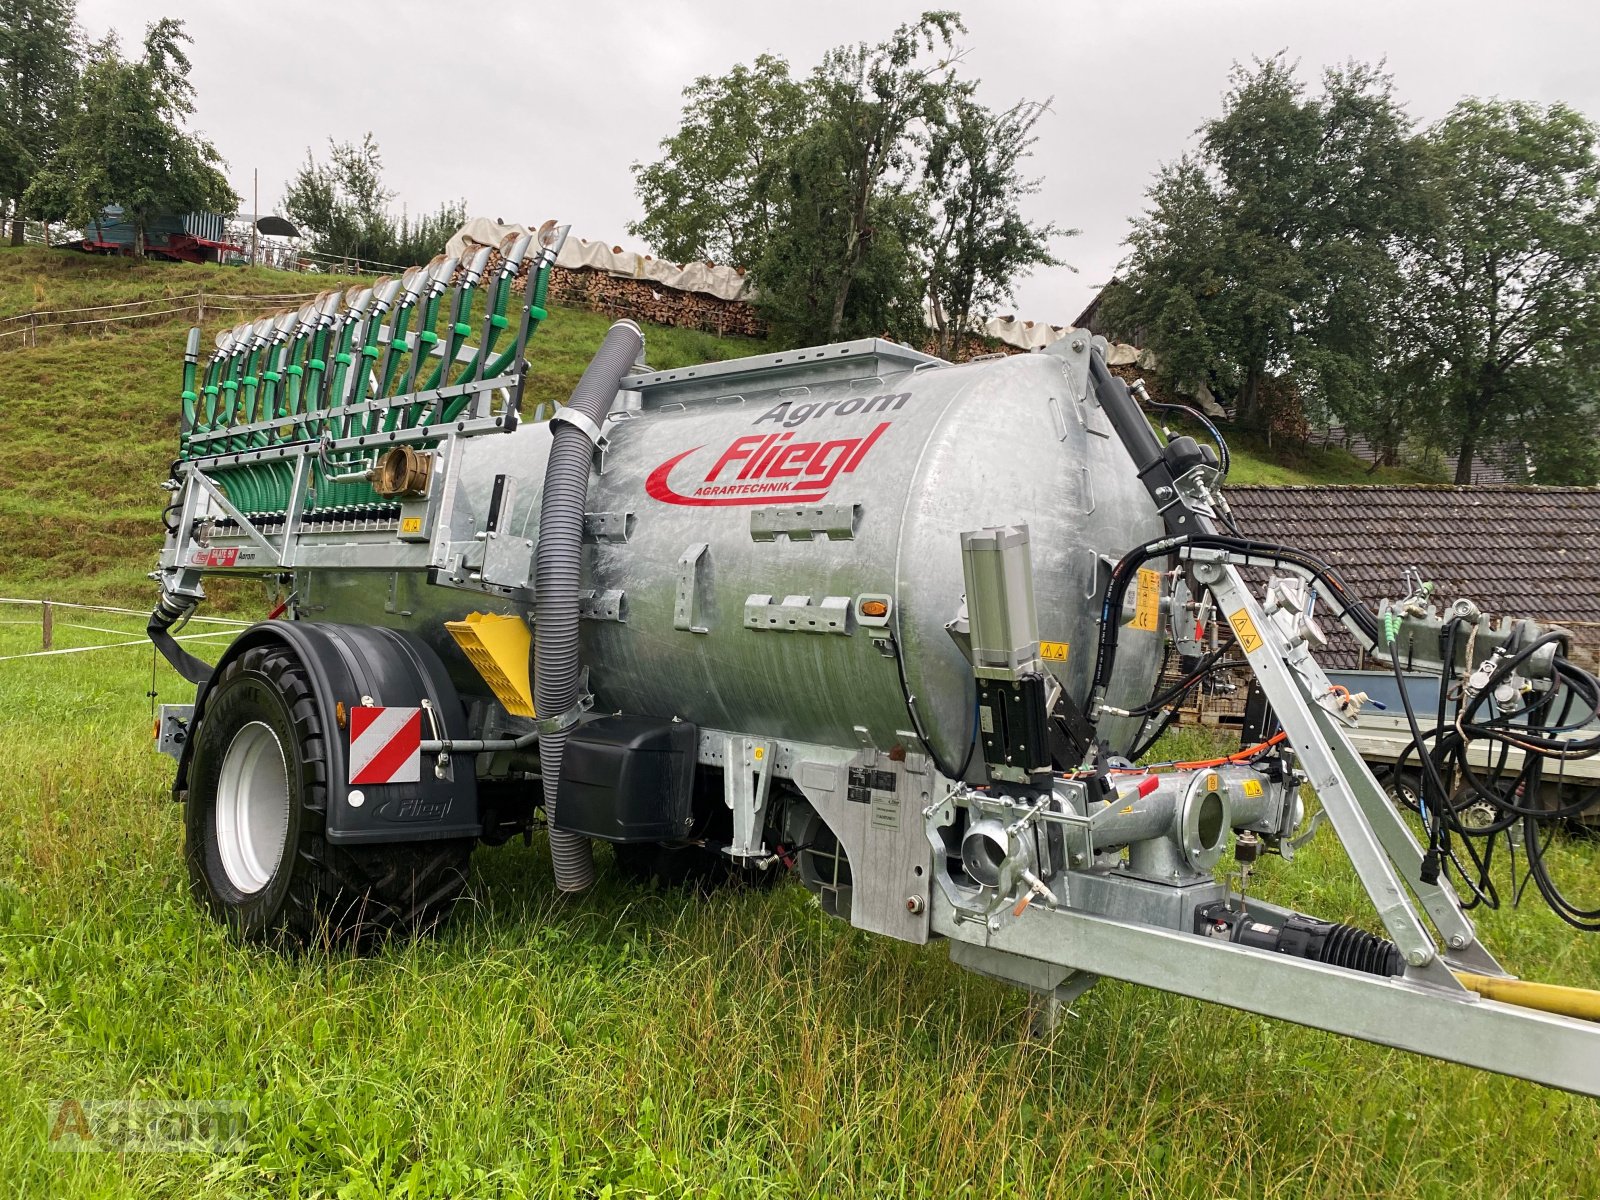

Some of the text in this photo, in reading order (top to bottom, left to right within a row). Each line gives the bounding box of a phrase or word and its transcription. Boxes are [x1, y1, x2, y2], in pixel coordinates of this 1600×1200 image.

[752, 392, 912, 428] Agrom
[704, 421, 892, 491] Fliegl
[694, 481, 793, 496] AGRARTECHNIK
[398, 797, 454, 820] Fliegl
